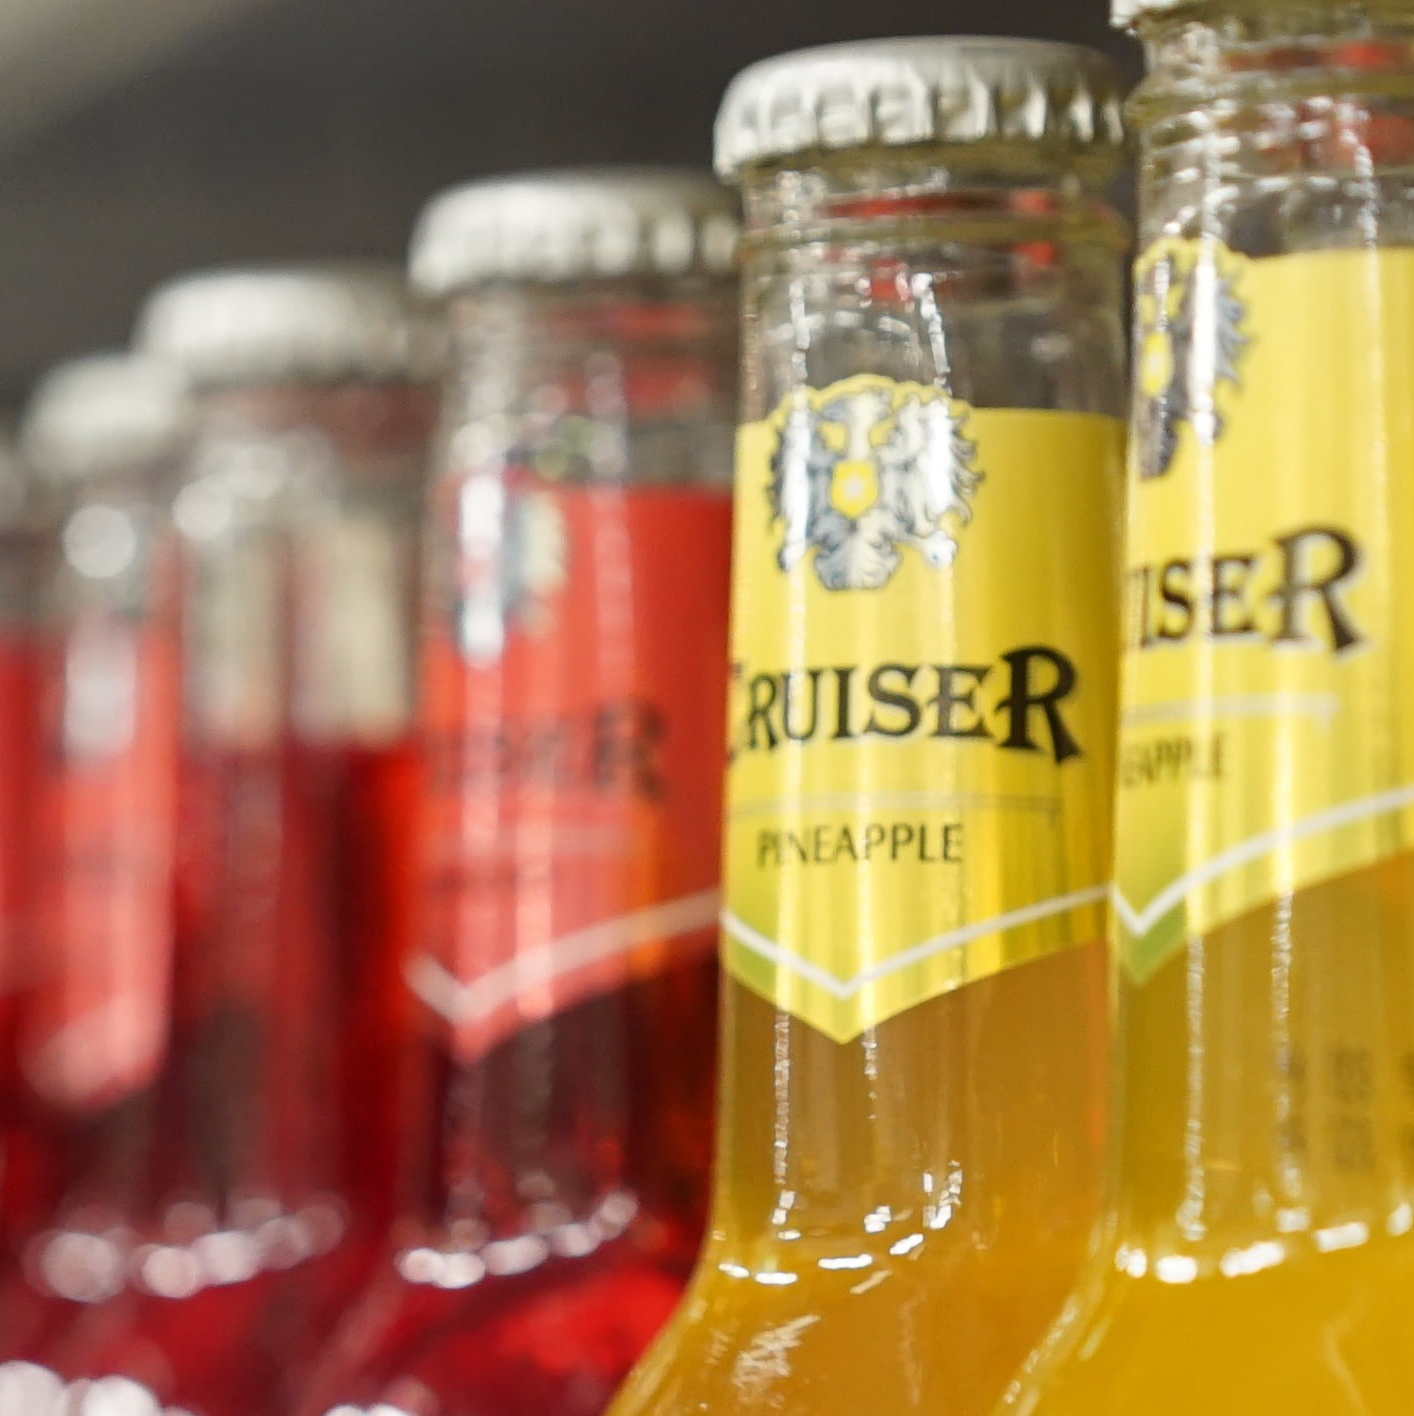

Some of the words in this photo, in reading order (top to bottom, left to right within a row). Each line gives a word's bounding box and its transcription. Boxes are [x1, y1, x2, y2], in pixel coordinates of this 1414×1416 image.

[1127, 524, 1363, 656] ISER
[731, 645, 1083, 764] RUISER
[756, 821, 965, 869] PINEAPPLE
